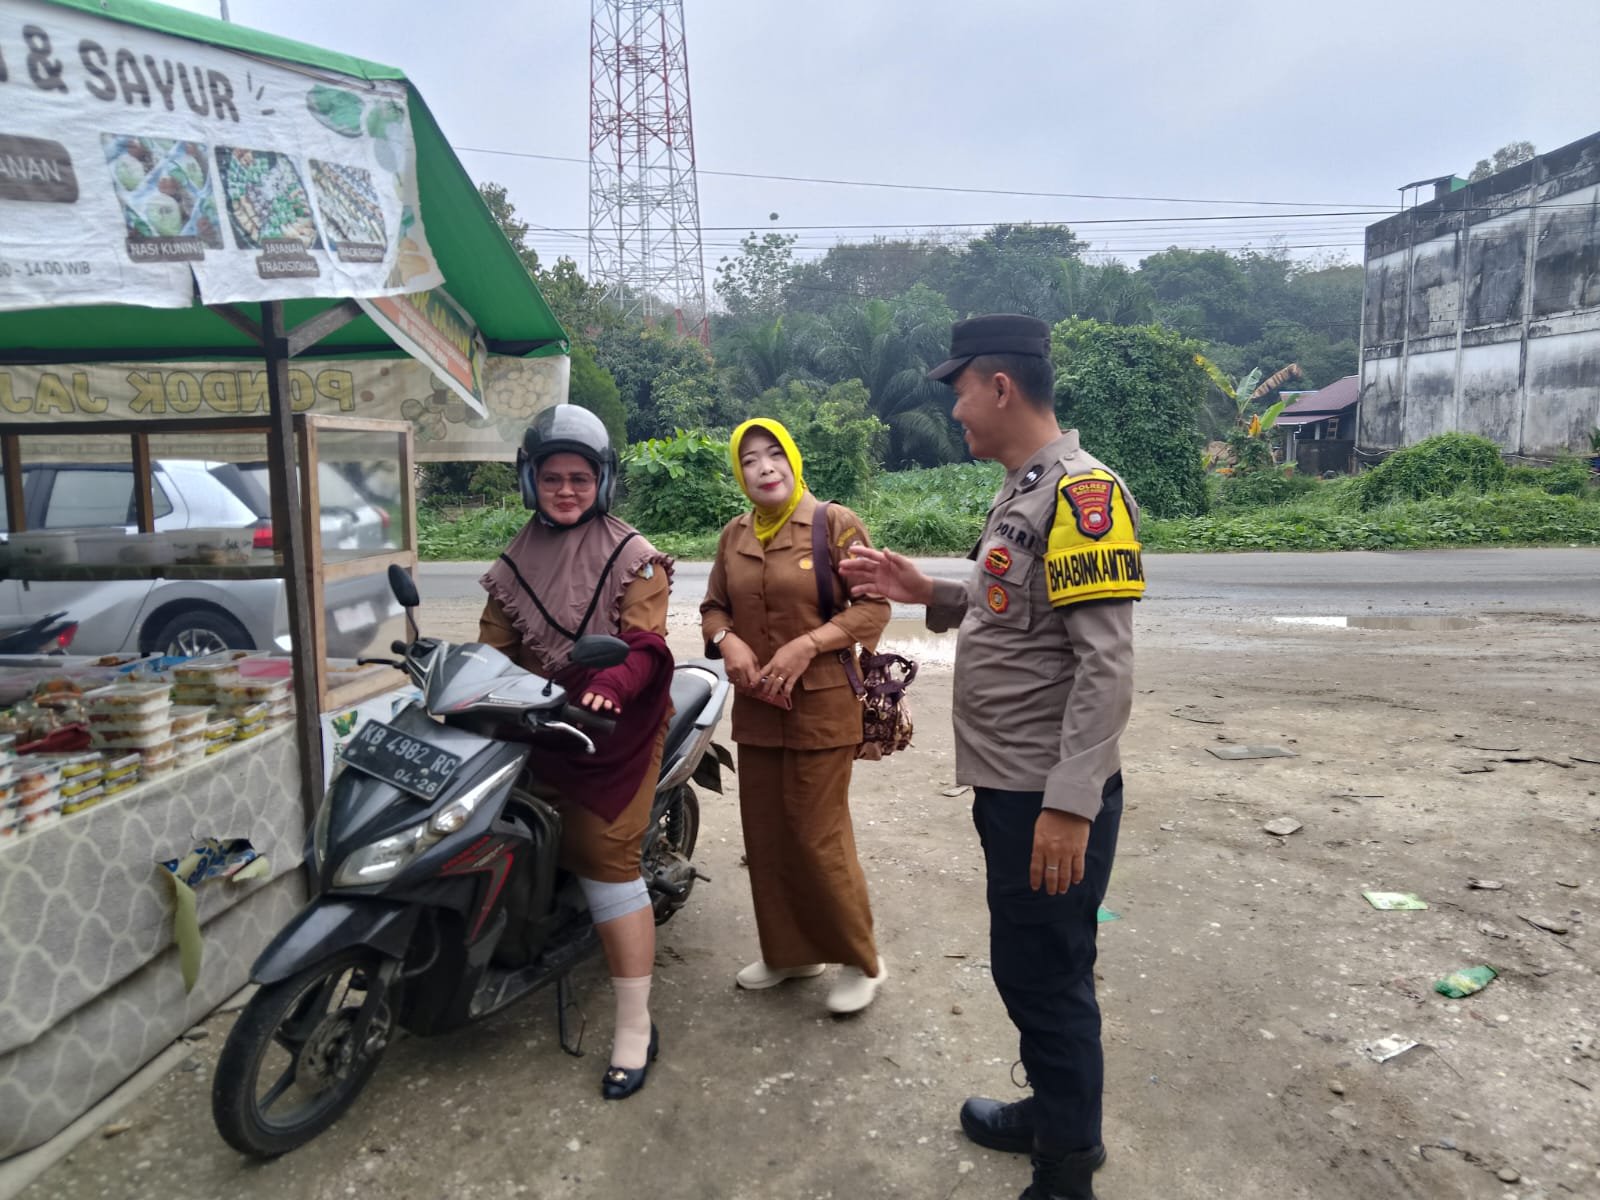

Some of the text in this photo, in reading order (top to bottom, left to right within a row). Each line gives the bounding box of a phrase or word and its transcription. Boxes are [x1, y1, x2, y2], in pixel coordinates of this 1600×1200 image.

[22, 24, 69, 94] &
[78, 39, 240, 122] SAYUR
[129, 243, 159, 256] NASI
[64, 260, 91, 275] WIB
[360, 723, 457, 776] KB 4982 RC
